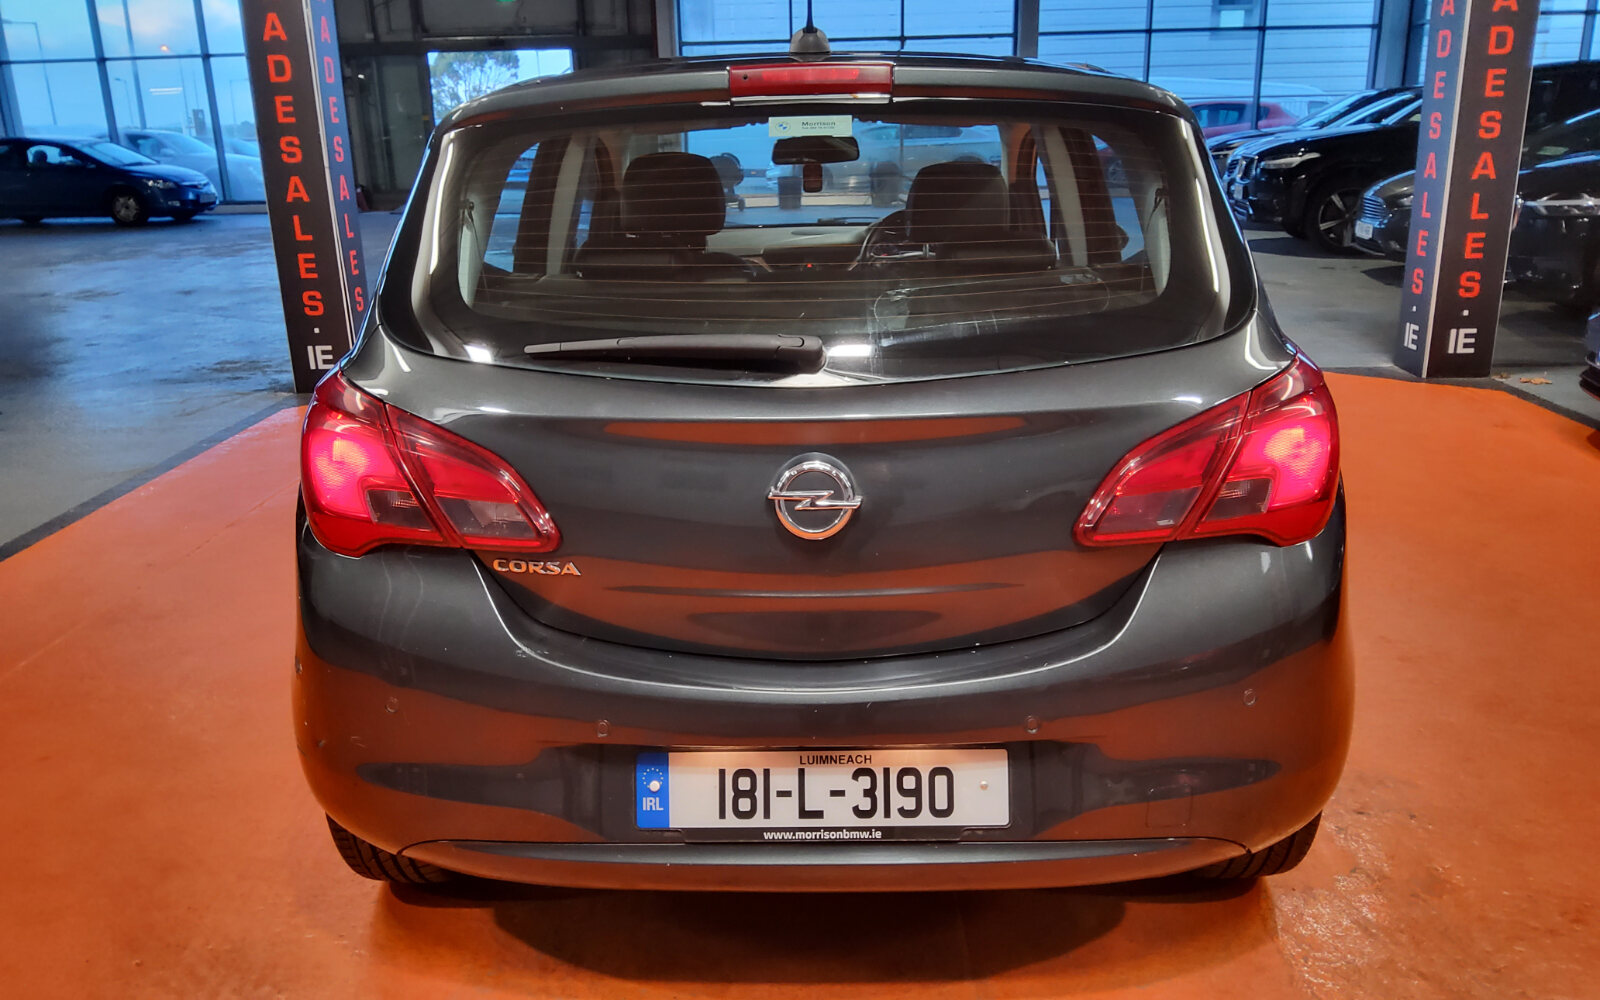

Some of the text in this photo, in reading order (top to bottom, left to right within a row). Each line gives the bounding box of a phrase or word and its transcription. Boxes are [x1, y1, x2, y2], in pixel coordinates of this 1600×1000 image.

[317, 0, 364, 313] ADESALES
[493, 559, 581, 576] CORSA
[799, 754, 872, 765] LUIMNEACH
[719, 766, 955, 820] 181-L-3190
[642, 796, 664, 811] IRL
[763, 828, 882, 840] www.morrisonbmw.ie
